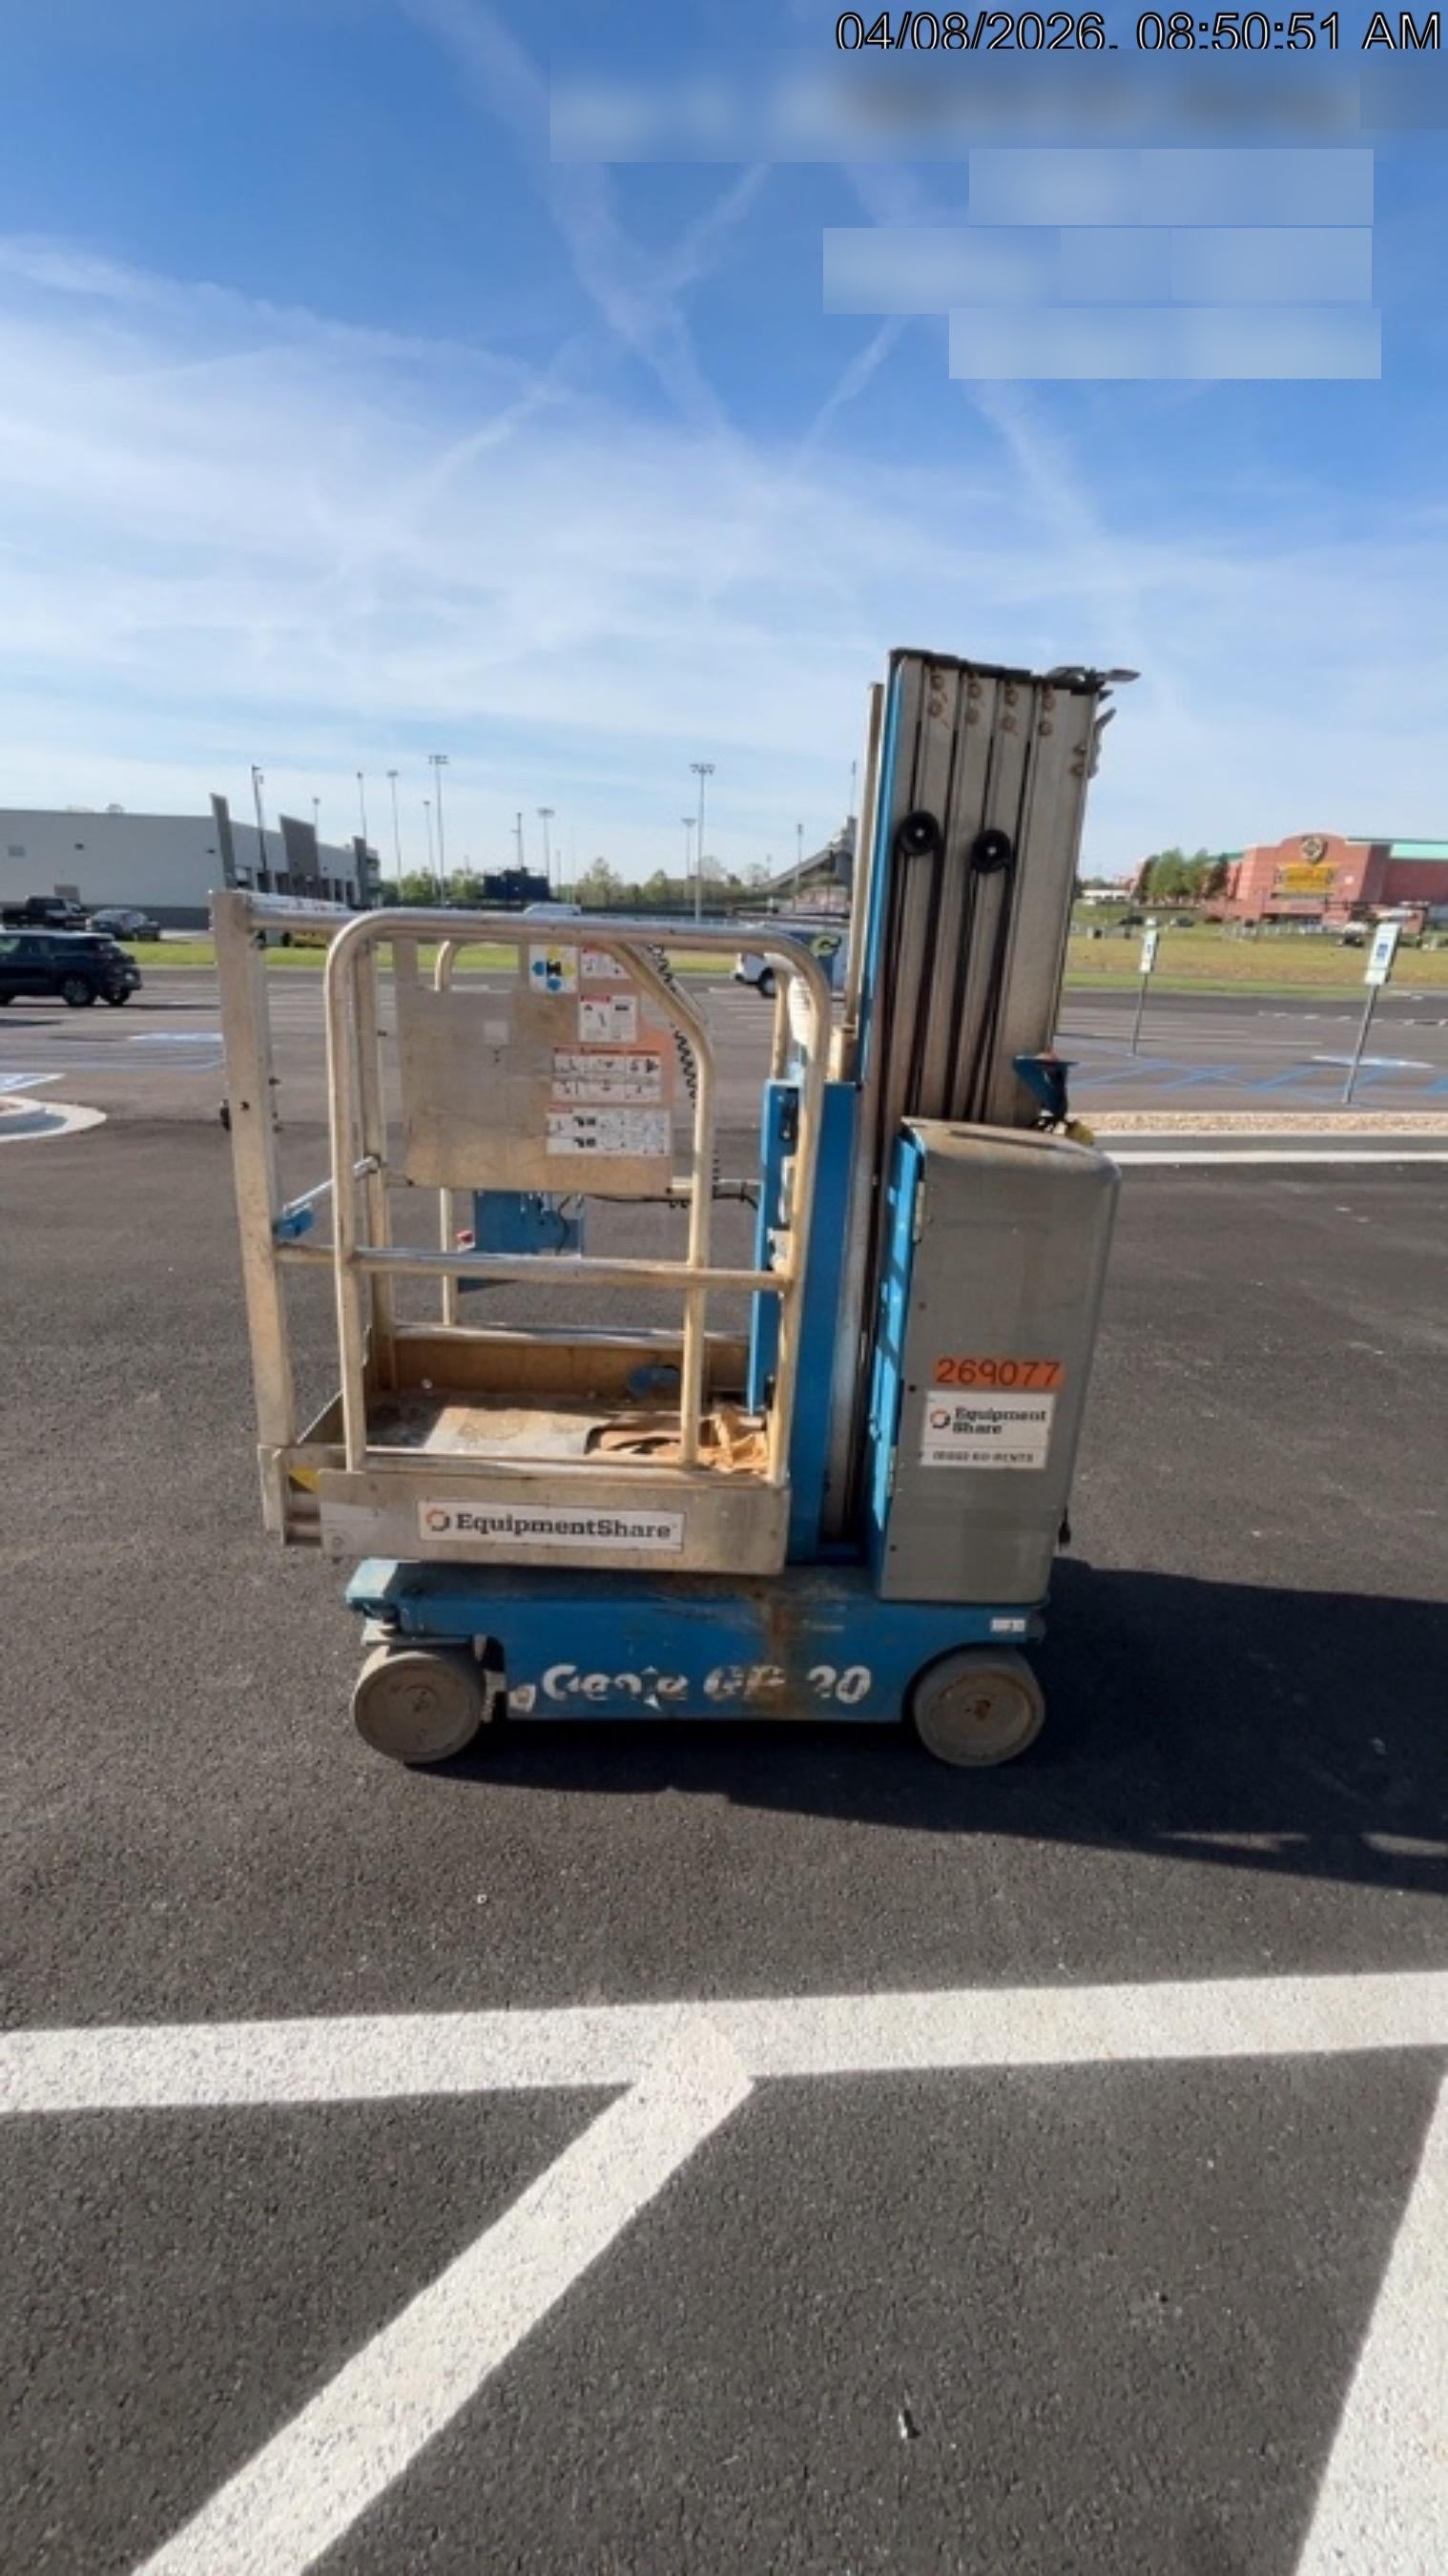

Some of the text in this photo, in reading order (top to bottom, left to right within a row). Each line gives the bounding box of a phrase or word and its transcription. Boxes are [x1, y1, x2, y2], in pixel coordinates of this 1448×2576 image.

[935, 1358, 1061, 1386] 269077
[953, 1421, 1003, 1435] Share
[955, 1406, 1046, 1423] Equipment
[455, 1512, 672, 1539] EquipmentShare
[807, 1664, 872, 1705] 20
